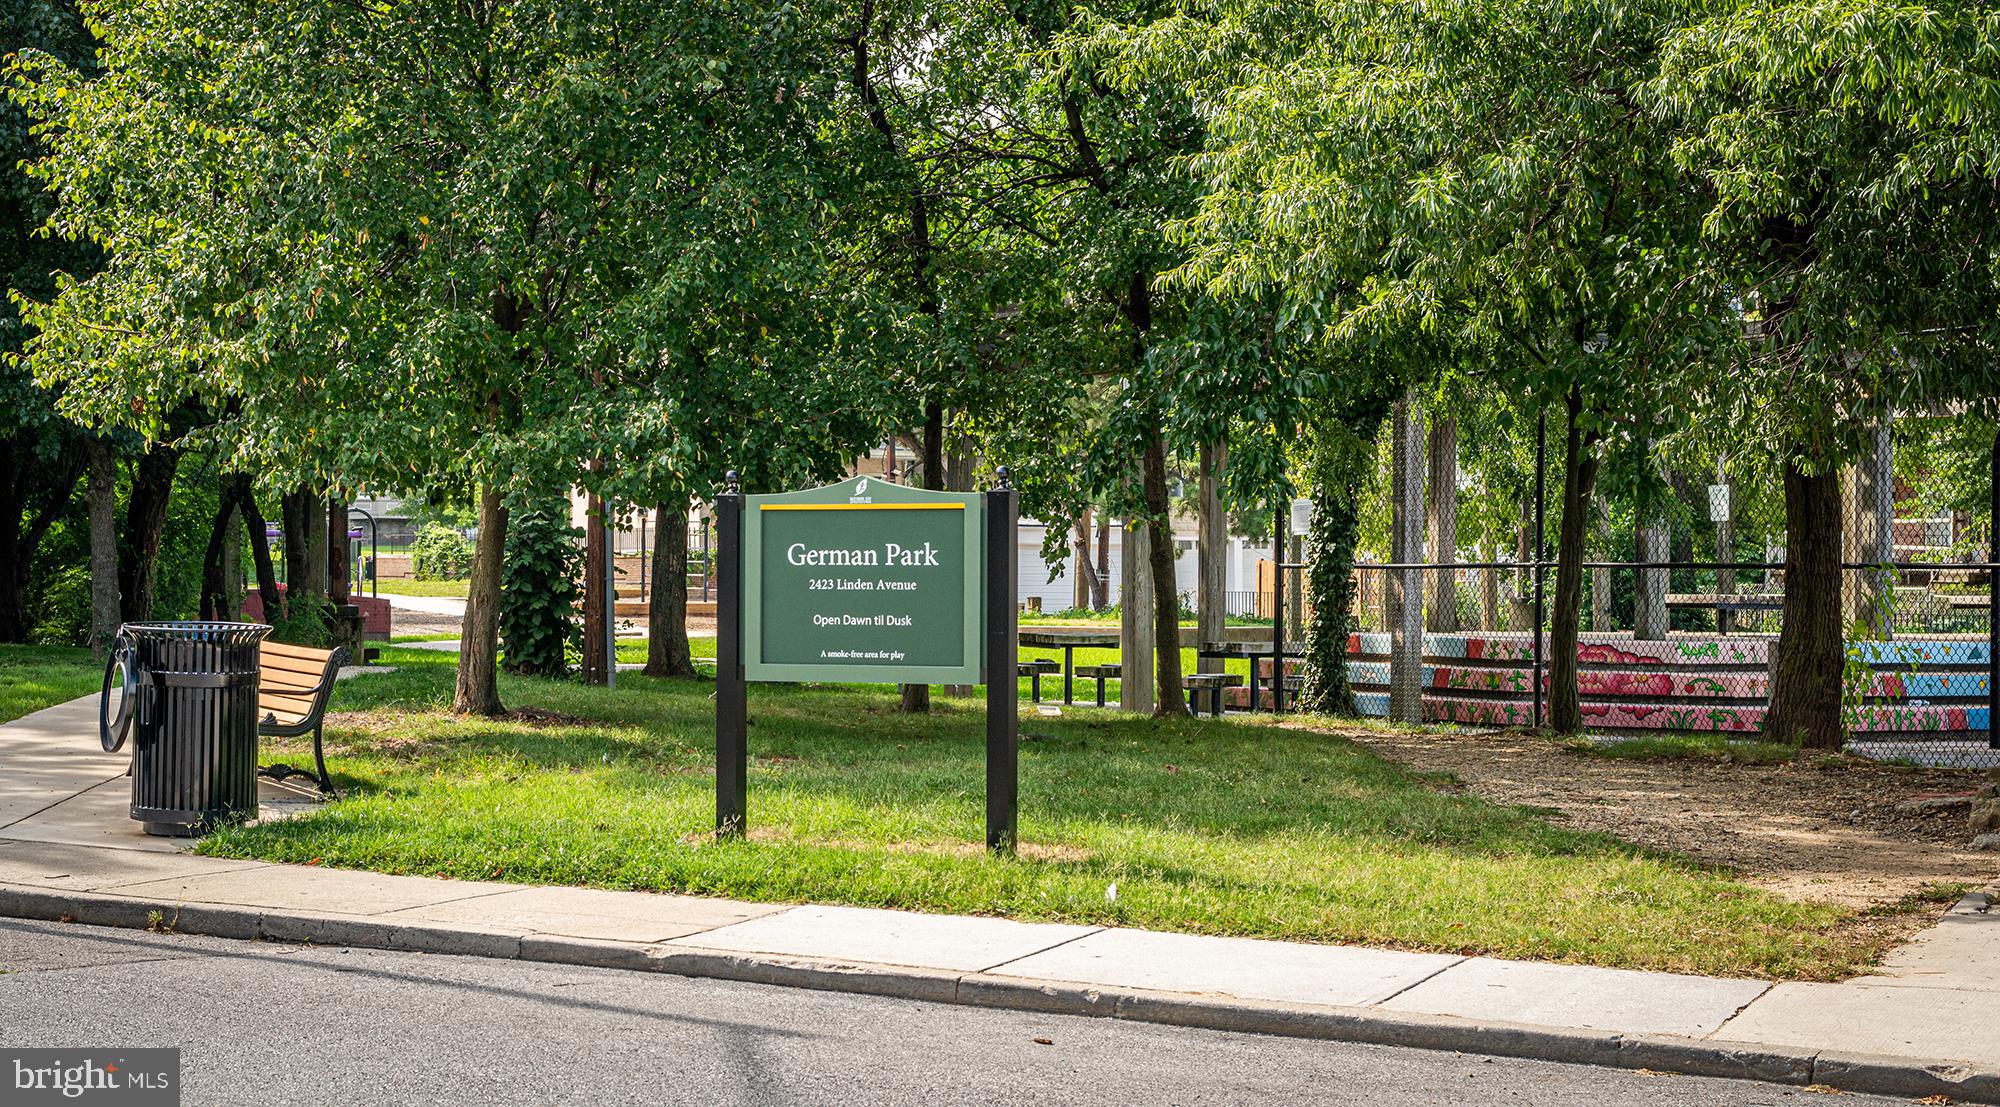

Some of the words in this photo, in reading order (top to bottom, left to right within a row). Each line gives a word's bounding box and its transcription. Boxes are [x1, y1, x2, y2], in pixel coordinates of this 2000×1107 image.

[786, 542, 879, 567] German
[884, 541, 940, 567] Park
[808, 578, 834, 590] 2423
[836, 578, 874, 591] Linden
[876, 578, 917, 591] Avenue
[812, 613, 841, 628] Open
[843, 614, 872, 626] Dawn
[874, 613, 885, 626] til
[886, 614, 913, 627] Dusk
[820, 649, 827, 658] A
[827, 649, 864, 659] smoke-free
[864, 651, 878, 659] area
[879, 649, 890, 659] for
[890, 650, 906, 661] play
